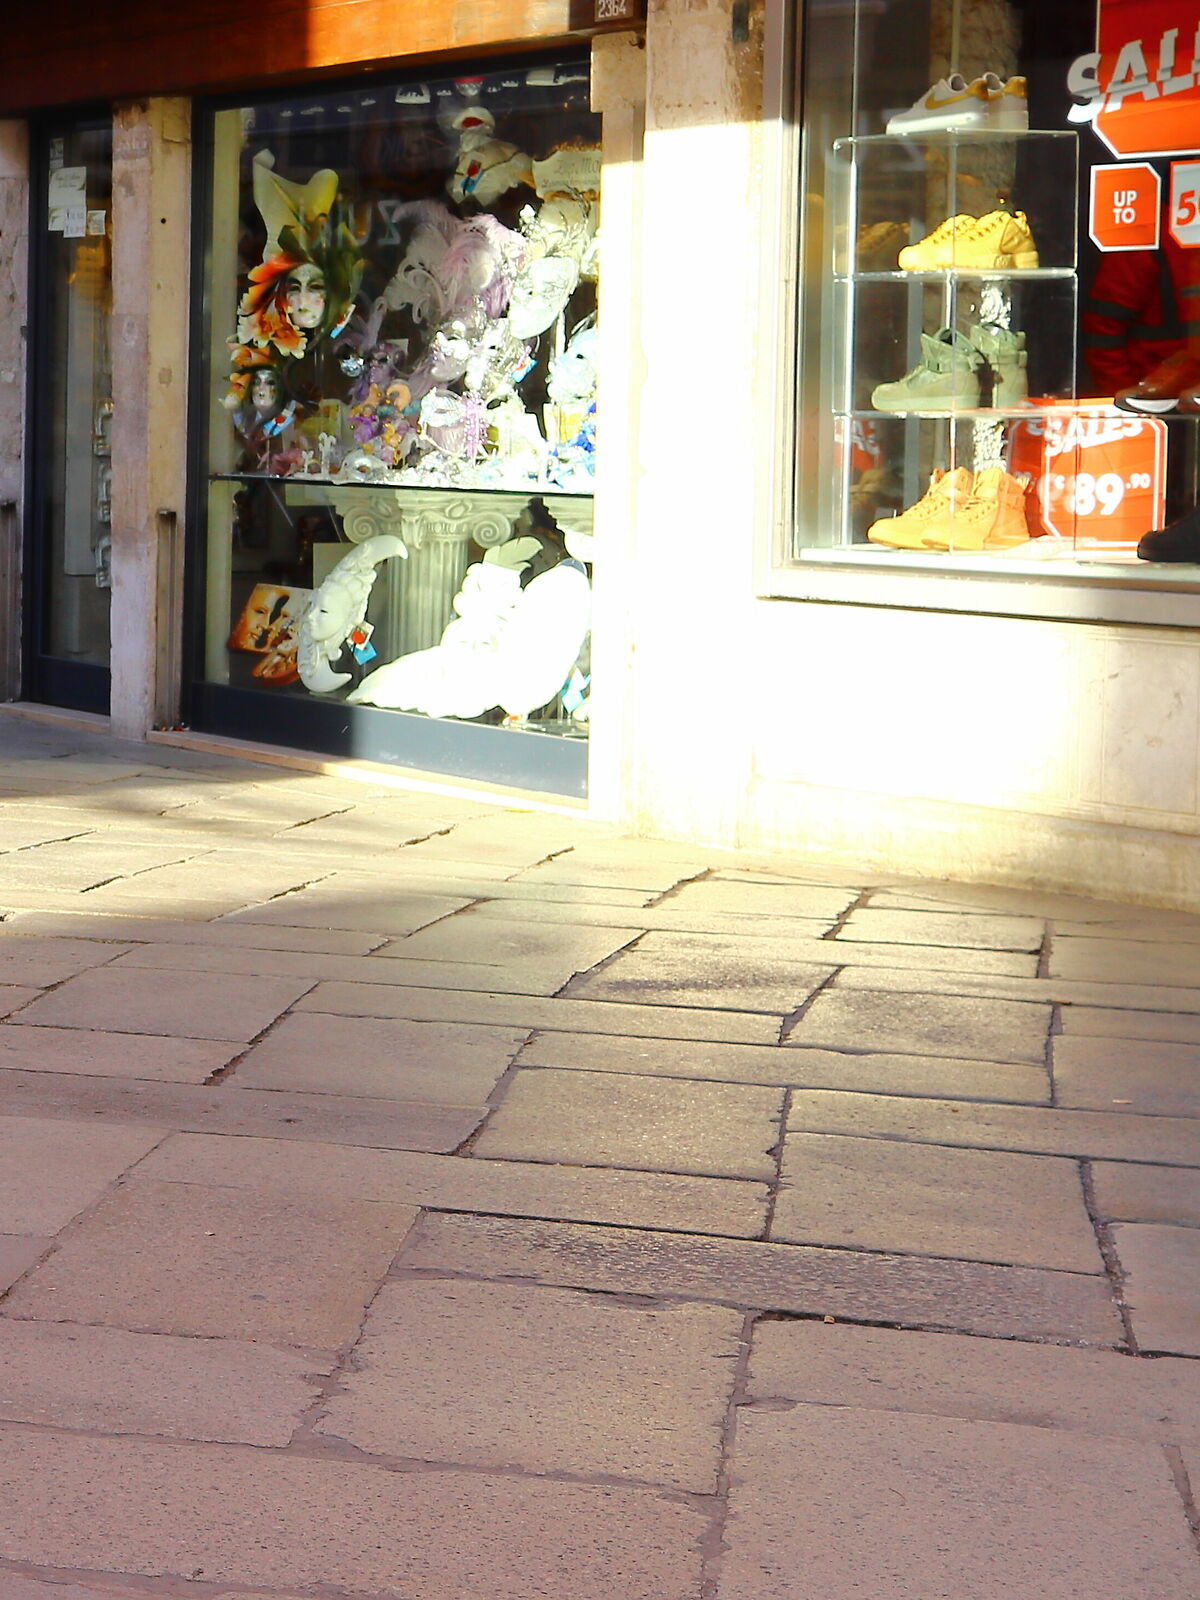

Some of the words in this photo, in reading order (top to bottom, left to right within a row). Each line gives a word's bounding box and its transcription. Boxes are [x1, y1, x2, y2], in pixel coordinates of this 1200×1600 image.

[1066, 20, 1200, 124] SAL
[1113, 191, 1137, 207] UP
[1176, 190, 1200, 226] 5
[1113, 208, 1136, 224] TO
